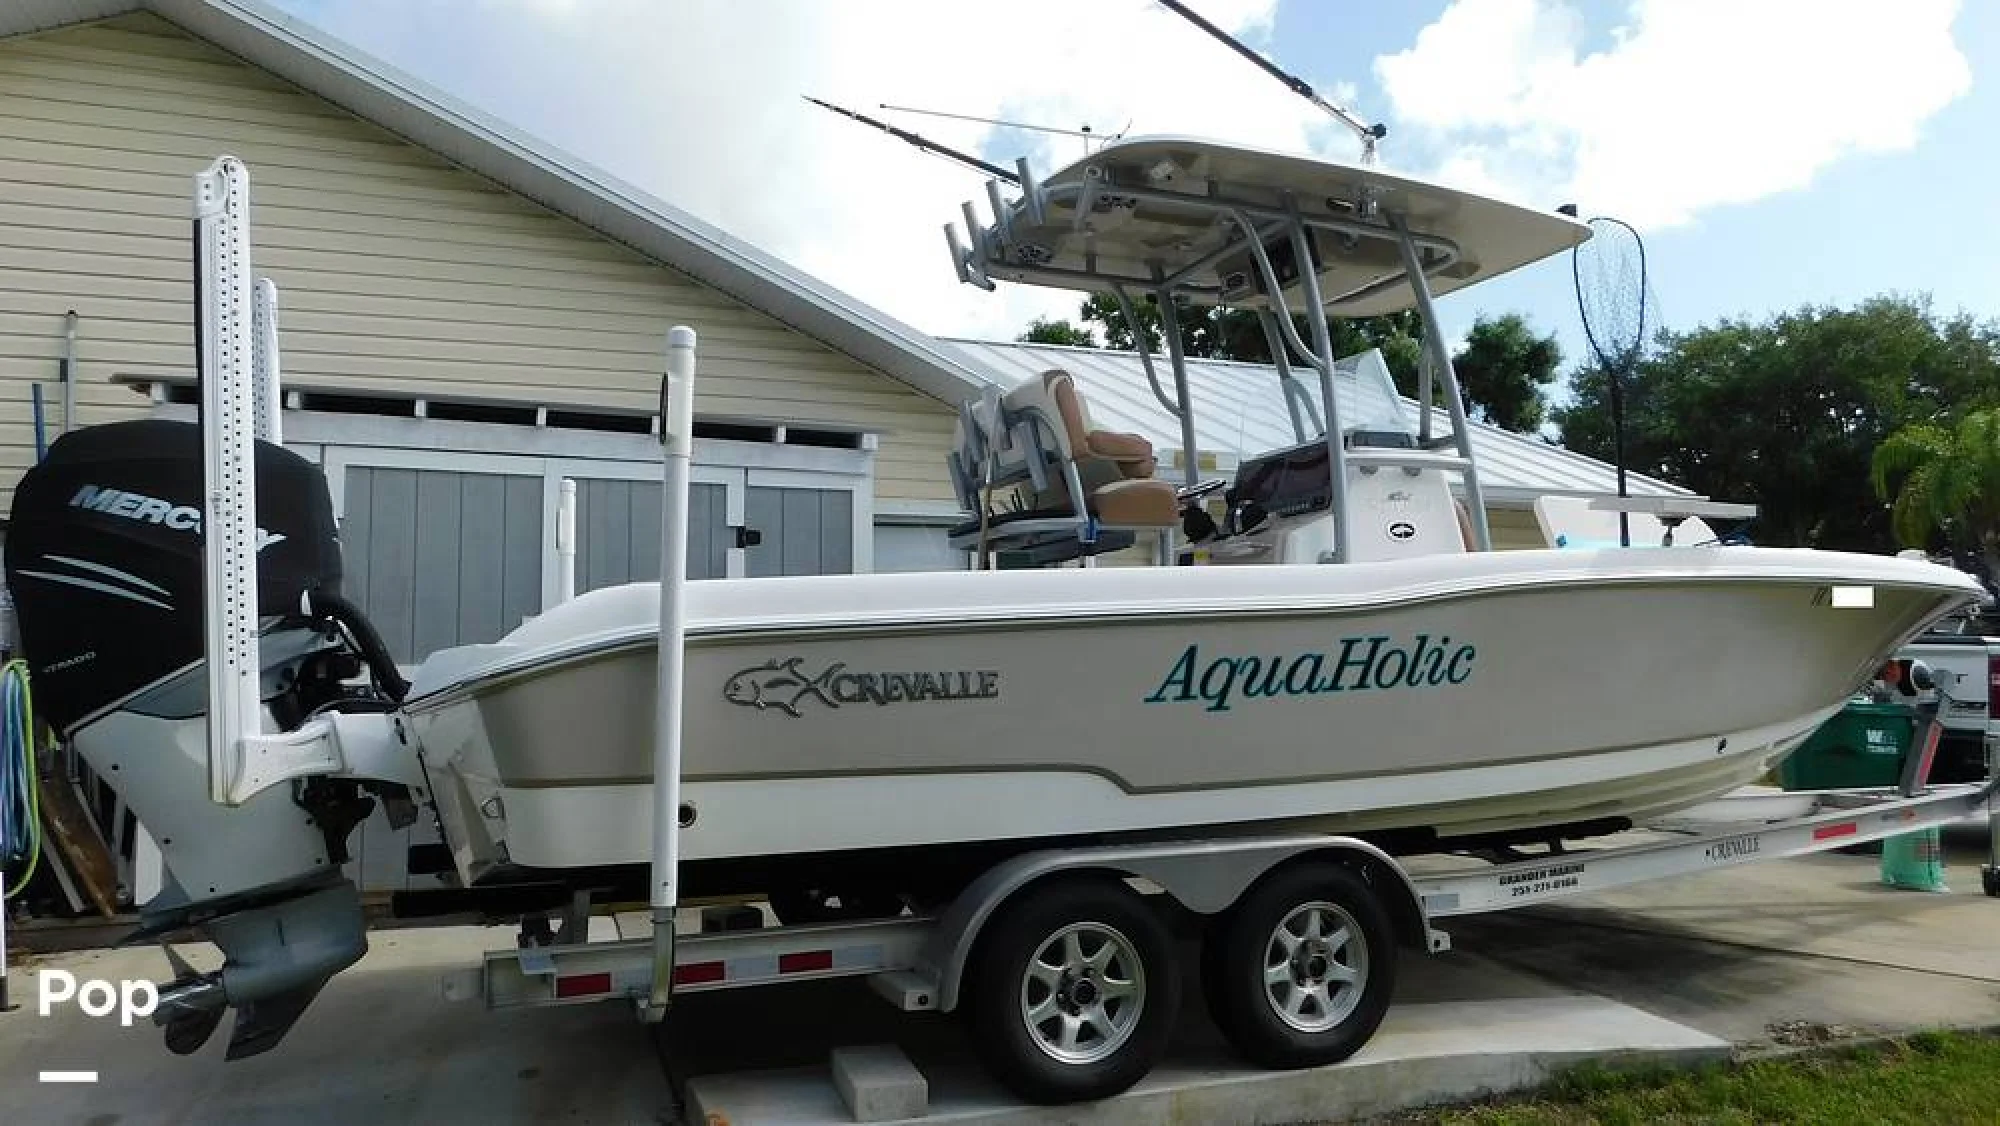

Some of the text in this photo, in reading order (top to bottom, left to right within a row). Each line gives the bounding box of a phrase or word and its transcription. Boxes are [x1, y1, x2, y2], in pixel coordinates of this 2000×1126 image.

[68, 485, 288, 553] MERCY
[831, 670, 999, 706] CREVALLE
[1144, 634, 1476, 712] AquaHolic
